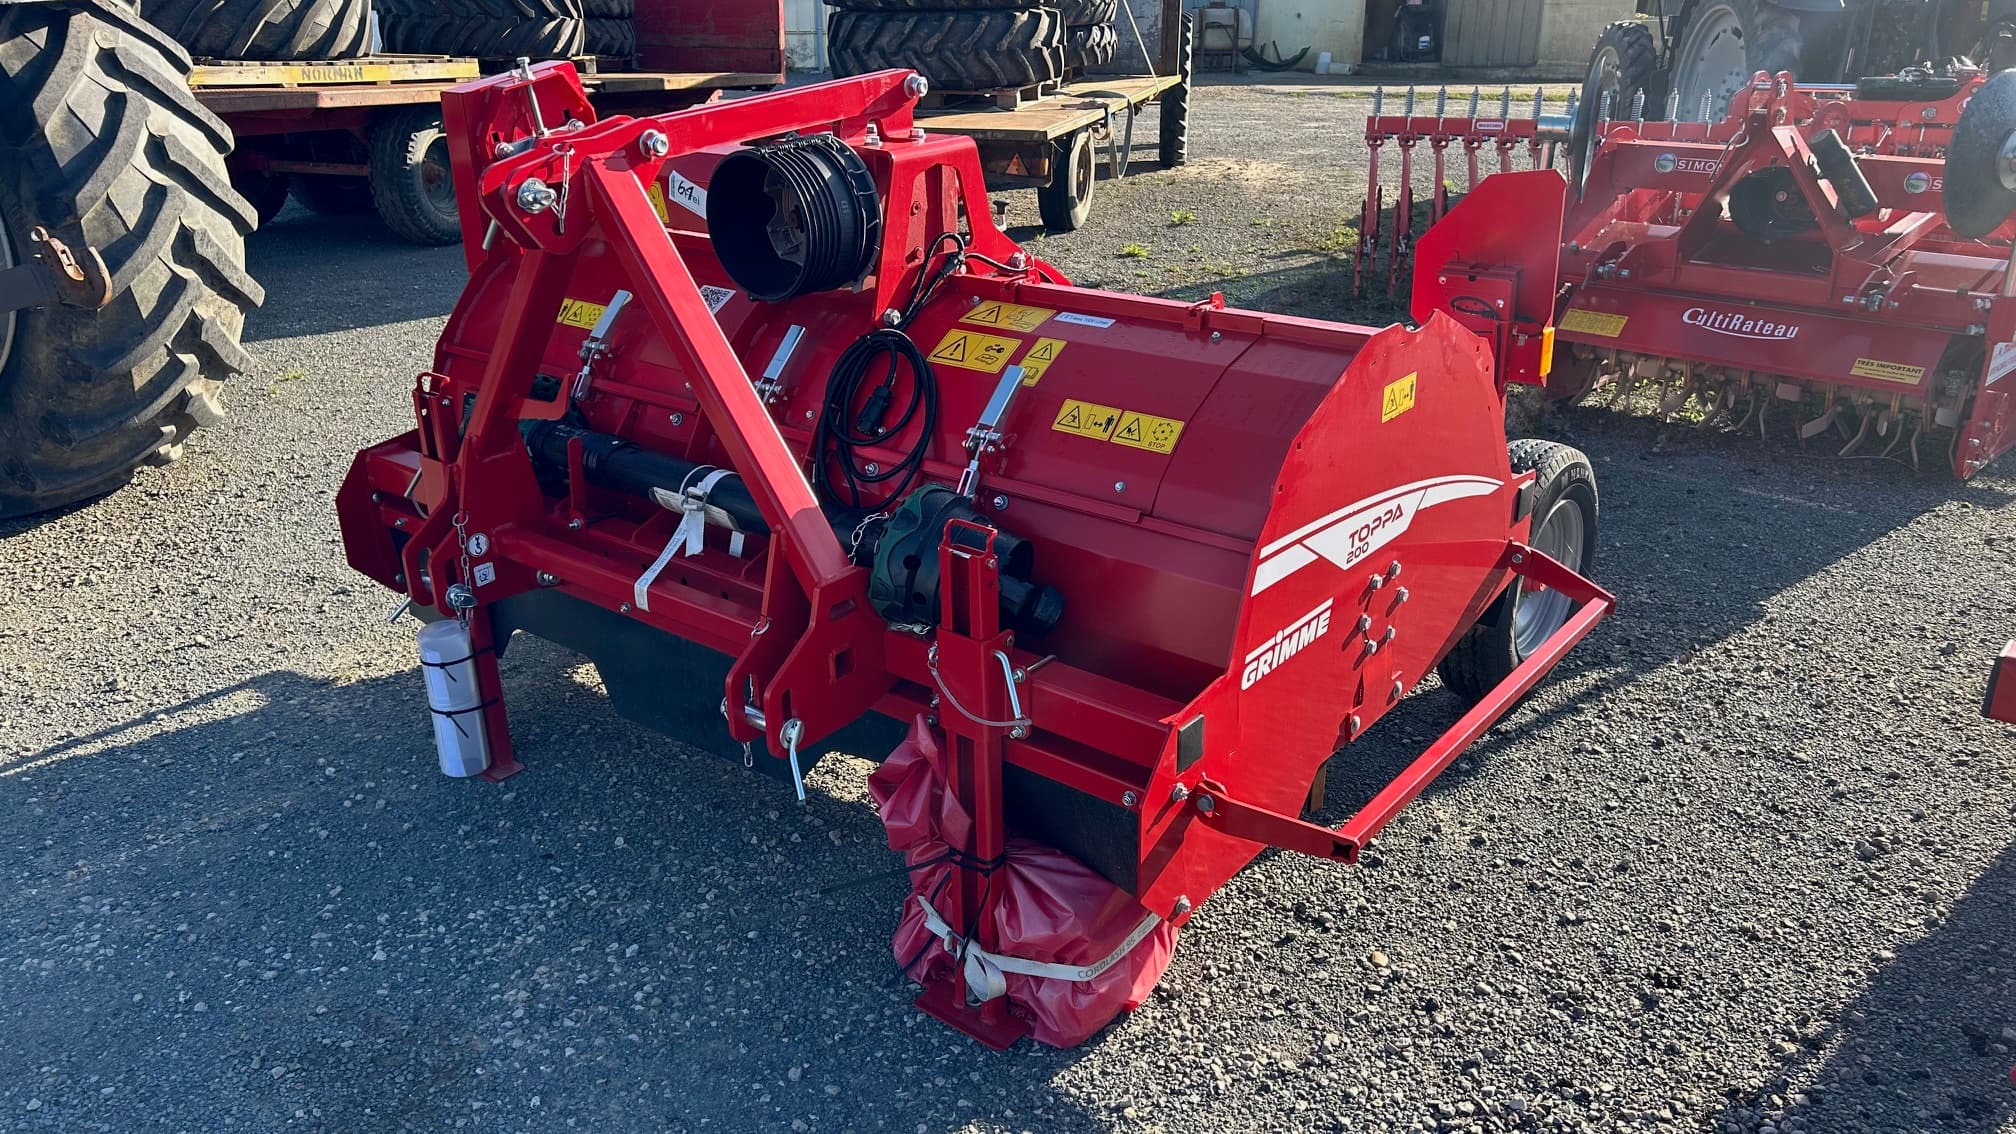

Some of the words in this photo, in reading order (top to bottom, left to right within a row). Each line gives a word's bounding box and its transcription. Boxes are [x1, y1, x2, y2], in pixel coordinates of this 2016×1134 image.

[302, 67, 363, 80] NORMAN
[1682, 308, 1799, 339] CultiRateau
[1876, 363, 1923, 374] IMPORTANT
[1148, 441, 1166, 449] STOP
[1348, 503, 1404, 549] TOPPA
[1346, 542, 1369, 565] 200
[1077, 946, 1126, 978] CORDLASH
